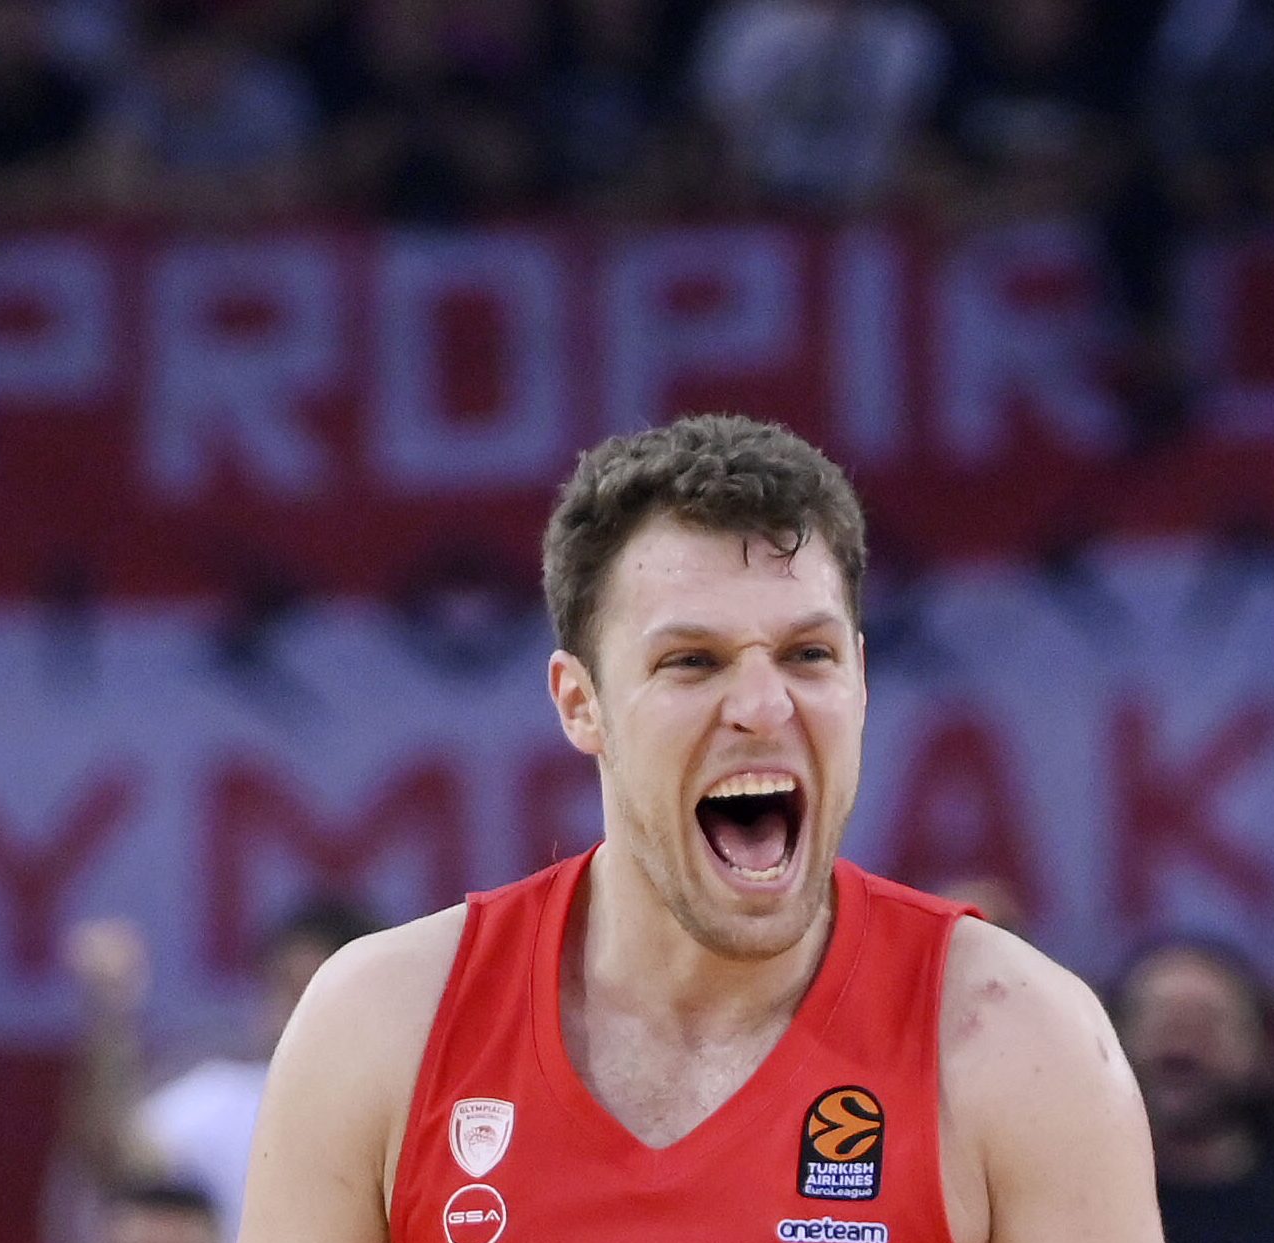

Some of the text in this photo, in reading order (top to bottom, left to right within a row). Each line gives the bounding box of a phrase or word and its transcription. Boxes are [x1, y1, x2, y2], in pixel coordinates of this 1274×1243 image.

[806, 1162, 875, 1175] TURKISH
[805, 1174, 874, 1187] AIRLINES
[804, 1185, 873, 1198] EuroLeague
[448, 1209, 501, 1225] GSA
[779, 1218, 887, 1243] oneteam
